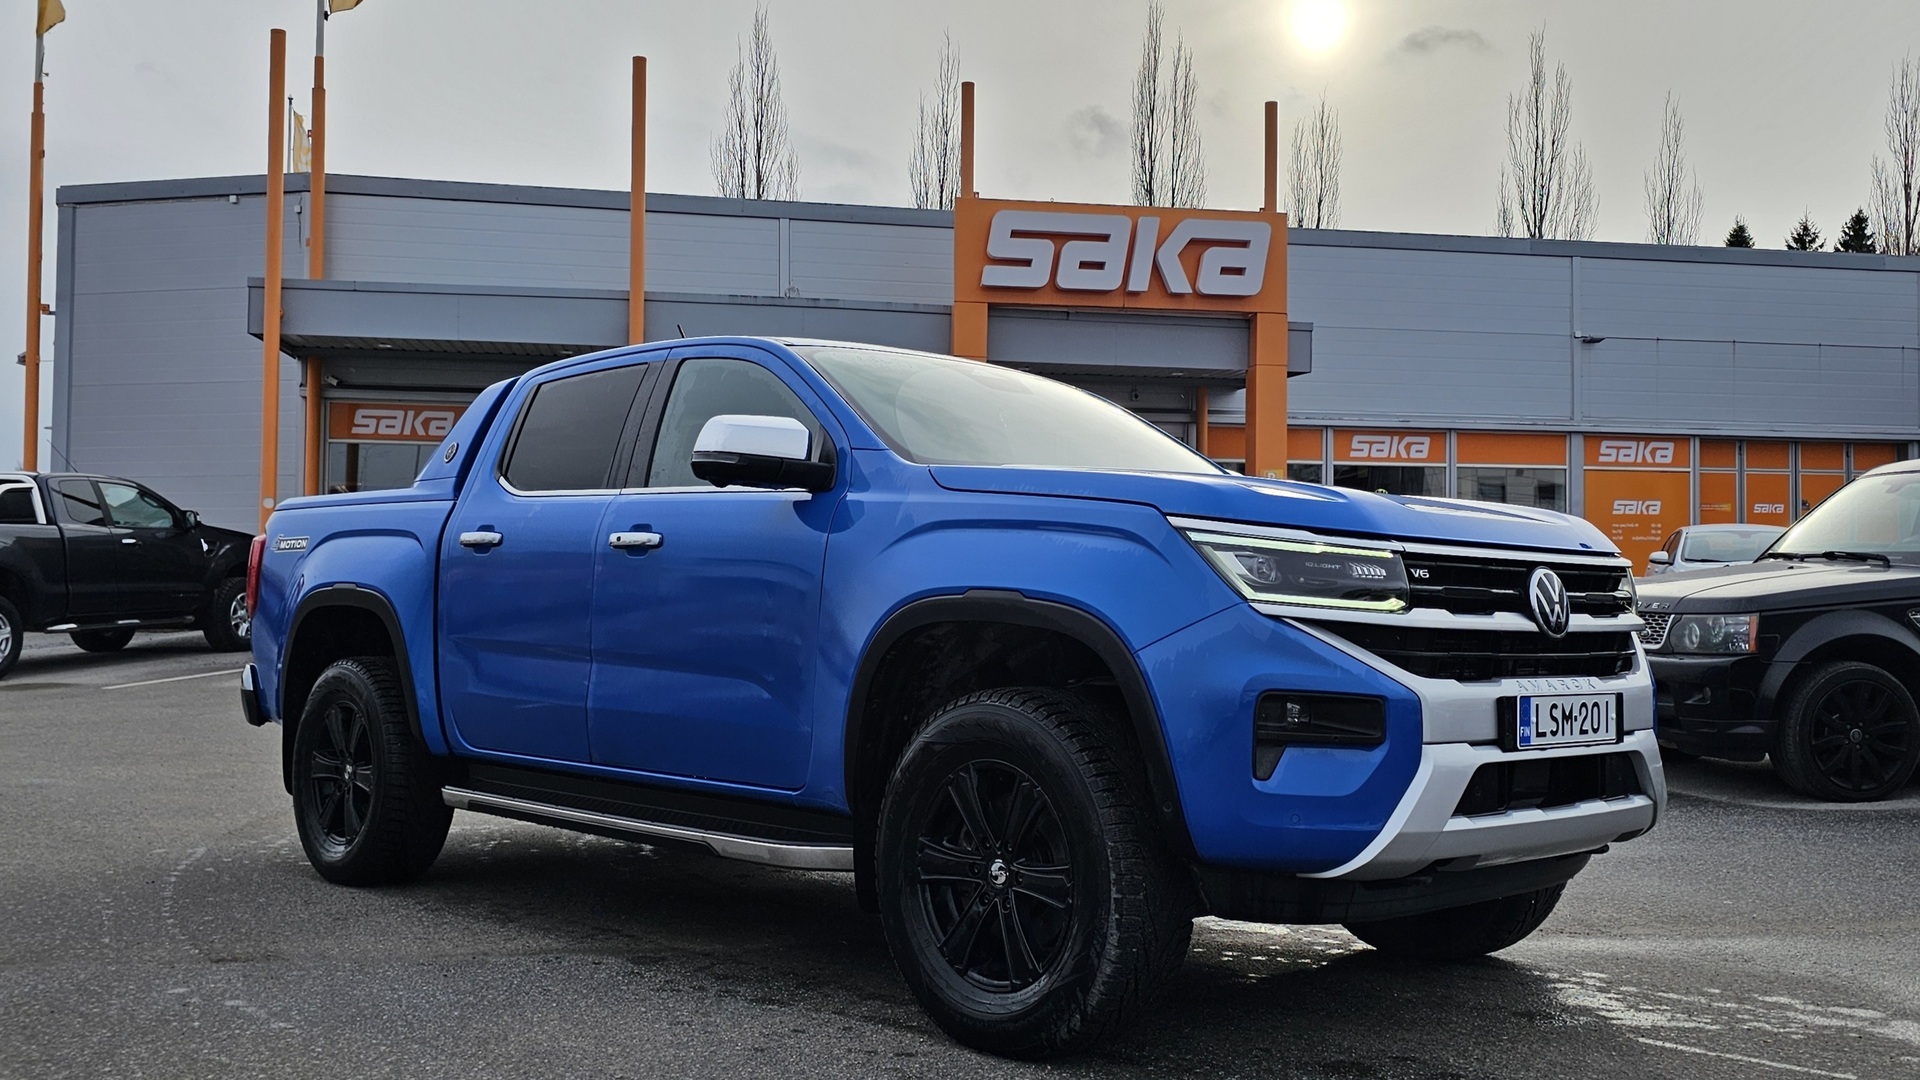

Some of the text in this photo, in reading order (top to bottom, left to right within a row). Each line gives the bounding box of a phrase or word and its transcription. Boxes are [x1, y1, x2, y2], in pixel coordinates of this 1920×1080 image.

[1409, 567, 1431, 579] V6
[1535, 700, 1610, 738] LSM-201
[1520, 726, 1531, 738] FIN
